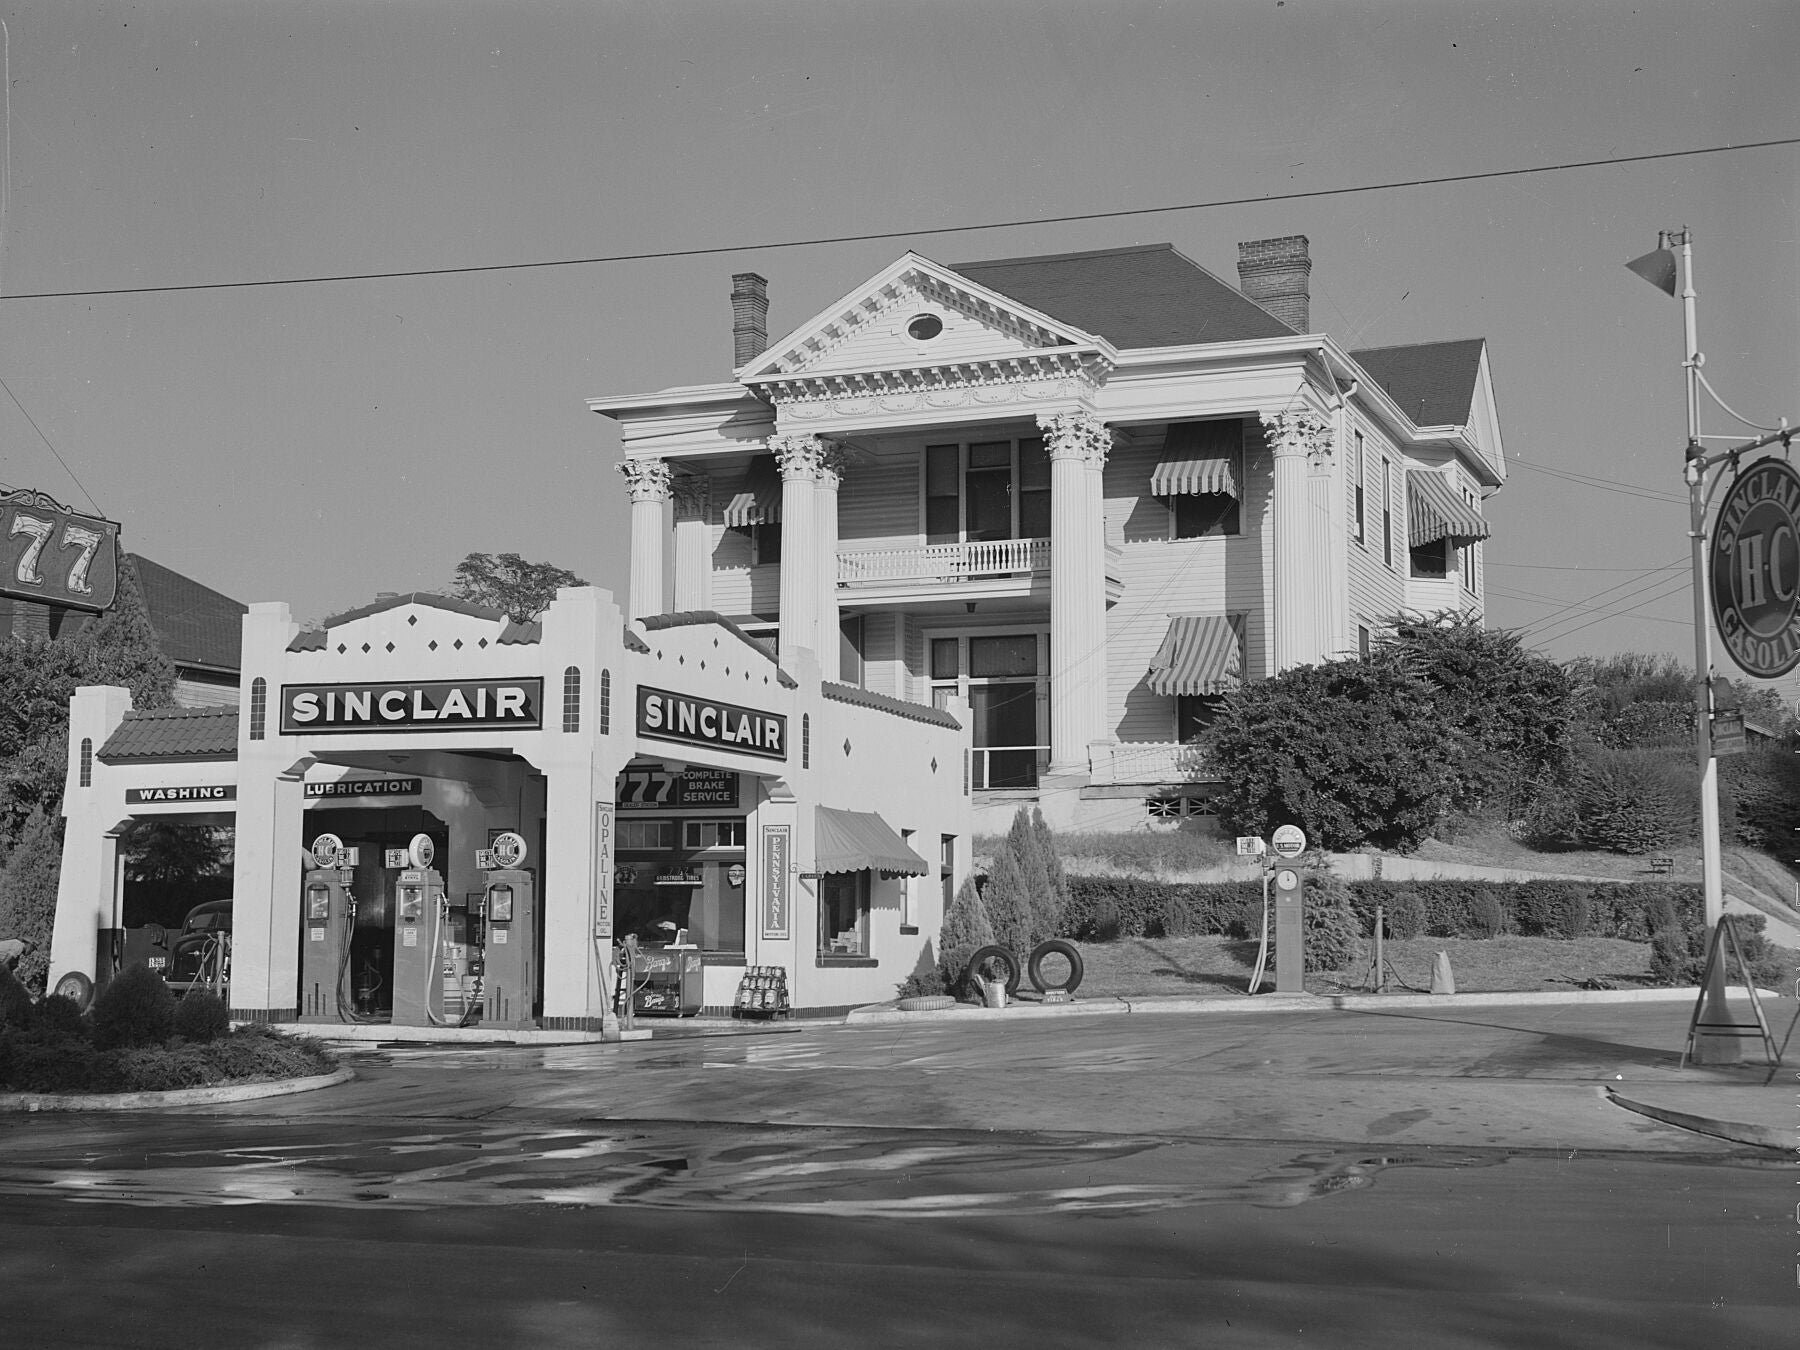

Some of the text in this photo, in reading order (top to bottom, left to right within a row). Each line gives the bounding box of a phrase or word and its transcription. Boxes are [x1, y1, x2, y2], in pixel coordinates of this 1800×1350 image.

[292, 687, 526, 722] SINCLAIR
[645, 695, 780, 750] SINCLAIR
[682, 771, 733, 780] COMPLETE
[305, 781, 412, 795] LUBRICATION
[688, 781, 725, 790] BRAKE
[139, 787, 225, 801] WASHING
[683, 791, 731, 802] SERVICE
[599, 813, 609, 920] OPALINE
[771, 837, 781, 929] PENNSYLVANIA
